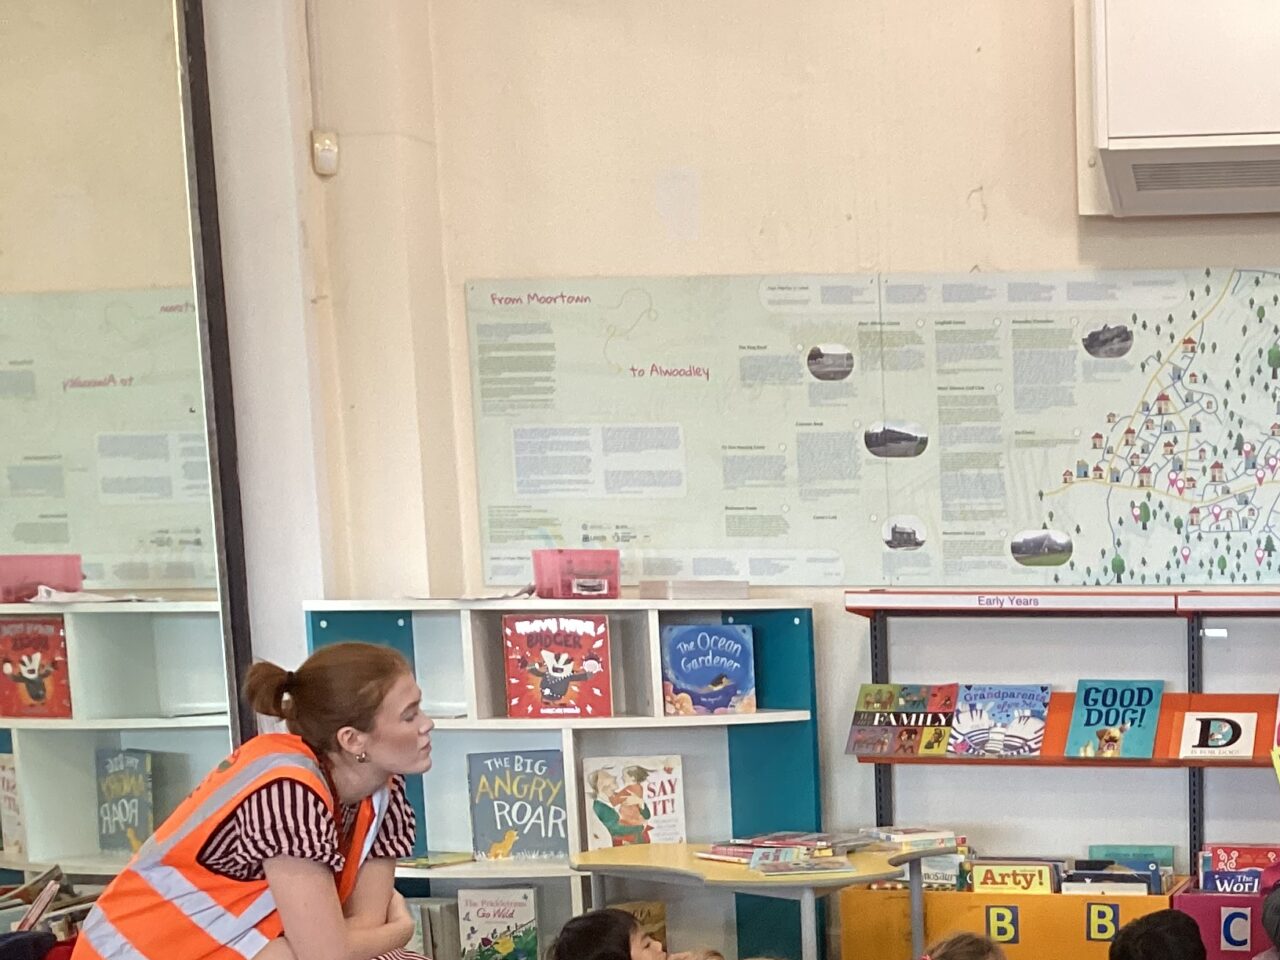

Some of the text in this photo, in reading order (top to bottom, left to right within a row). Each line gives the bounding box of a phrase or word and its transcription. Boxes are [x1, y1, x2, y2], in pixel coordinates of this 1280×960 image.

[490, 292, 591, 305] From Moortown
[629, 363, 710, 381] to Alwoodley
[978, 596, 1039, 607] Early Years
[527, 633, 582, 649] BADGER
[676, 632, 742, 657] The Ocean
[681, 650, 740, 673] Gardener
[964, 690, 1046, 702] Grandparents
[1083, 686, 1154, 708] GOOD
[873, 712, 952, 726] FAMILY
[1083, 708, 1146, 728] DOG!
[1191, 717, 1243, 748] D
[484, 755, 547, 775] THE BIG
[475, 771, 562, 806] ANGRY
[647, 778, 678, 798] SAY
[652, 798, 676, 816] IT!
[493, 800, 567, 838] ROAR
[924, 872, 954, 881] nosaur
[979, 869, 1043, 890] Arty!
[1215, 876, 1259, 893] Worl
[1236, 874, 1253, 883] The
[477, 907, 515, 918] Go Wild
[1090, 904, 1116, 939] B
[989, 906, 1015, 941] B
[1223, 911, 1249, 947] C
